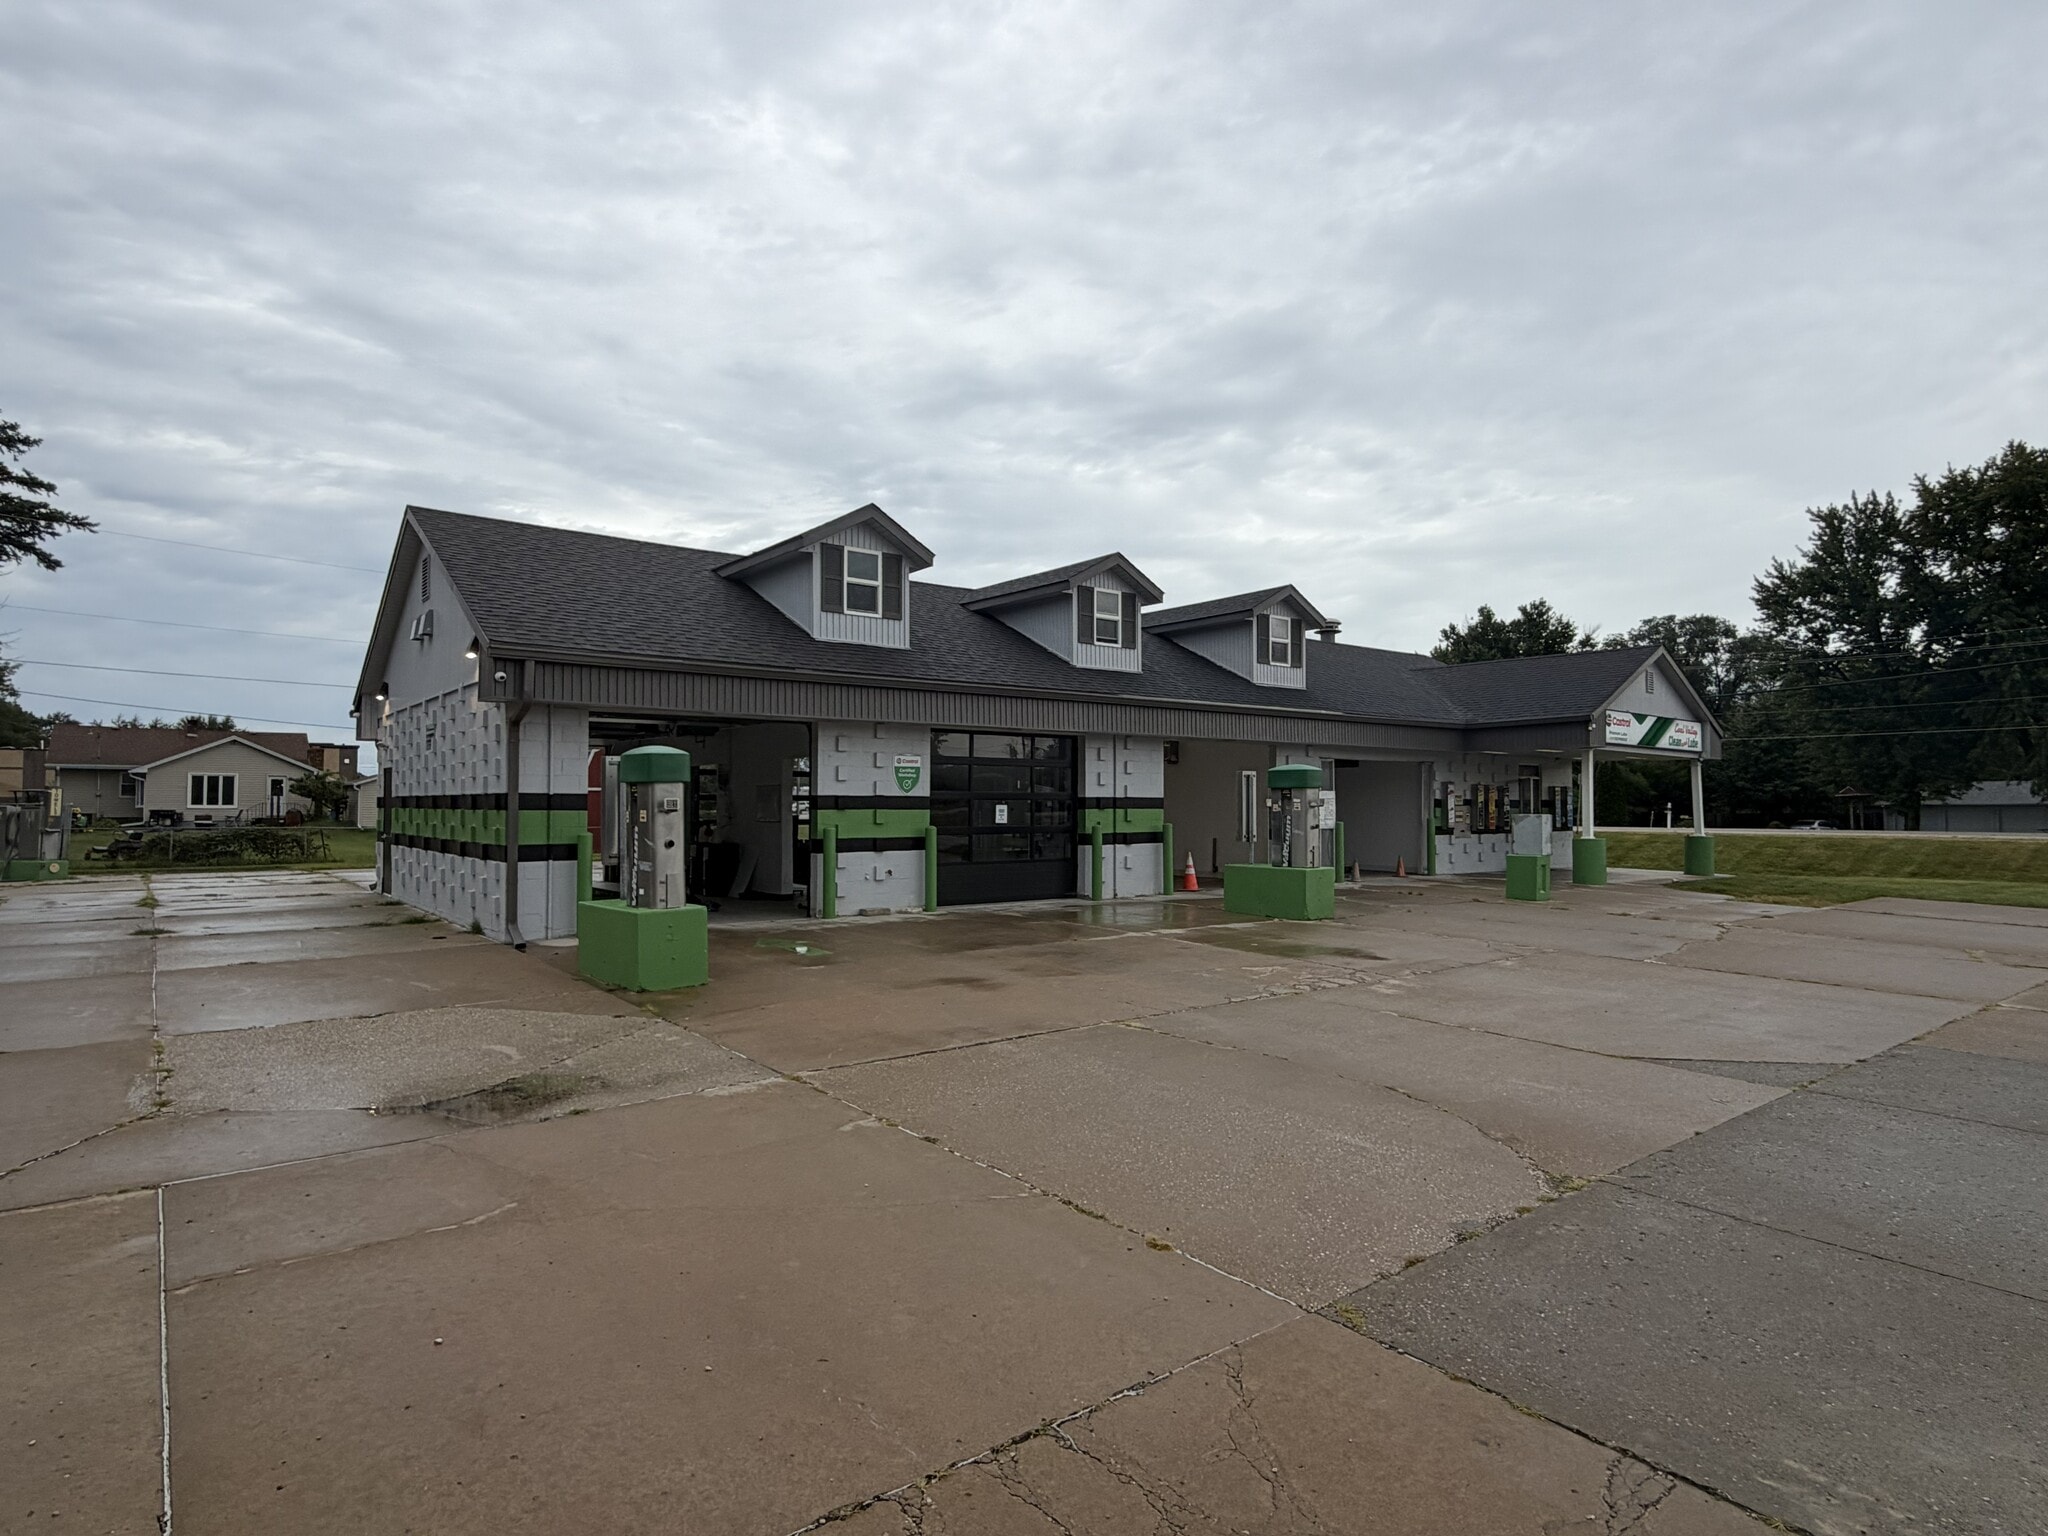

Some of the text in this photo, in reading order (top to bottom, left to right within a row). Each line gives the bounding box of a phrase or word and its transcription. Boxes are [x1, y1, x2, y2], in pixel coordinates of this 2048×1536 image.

[1612, 717, 1631, 727] Castrol
[1668, 735, 1682, 747] Clean
[1688, 737, 1699, 749] Lube
